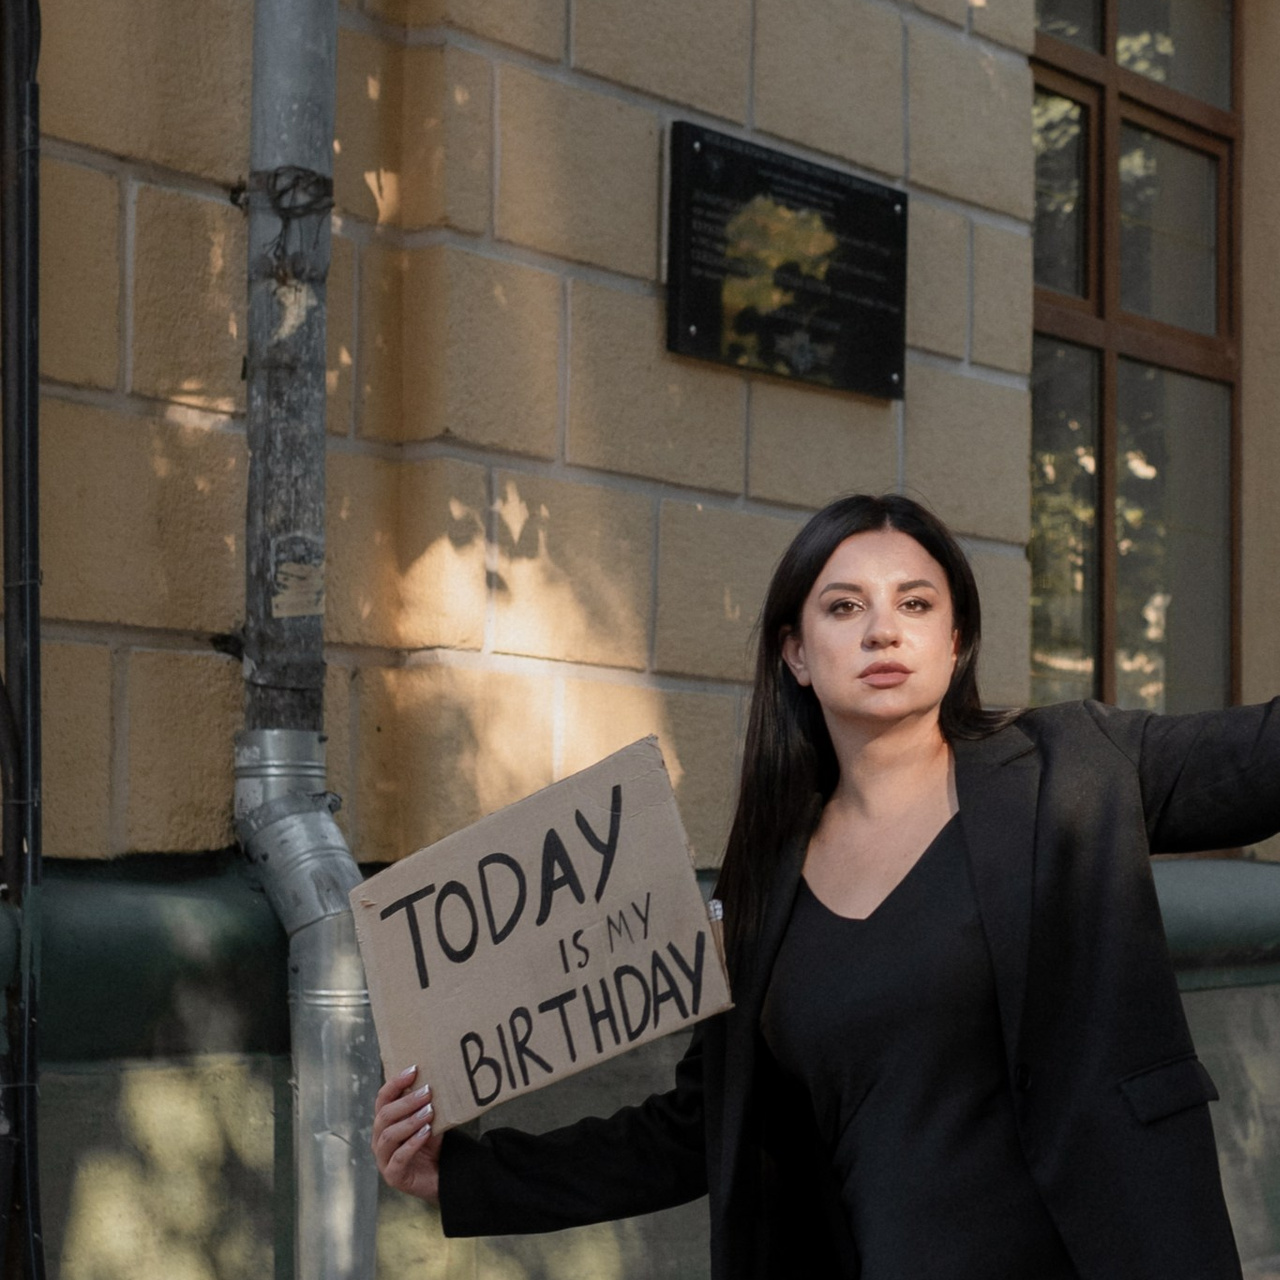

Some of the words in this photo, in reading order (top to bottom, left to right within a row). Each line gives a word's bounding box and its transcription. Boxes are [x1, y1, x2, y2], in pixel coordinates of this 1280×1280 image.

[379, 784, 622, 990] TODAY
[558, 928, 590, 975] IS
[605, 891, 651, 954] MY
[459, 930, 706, 1108] BIRTHDAY
